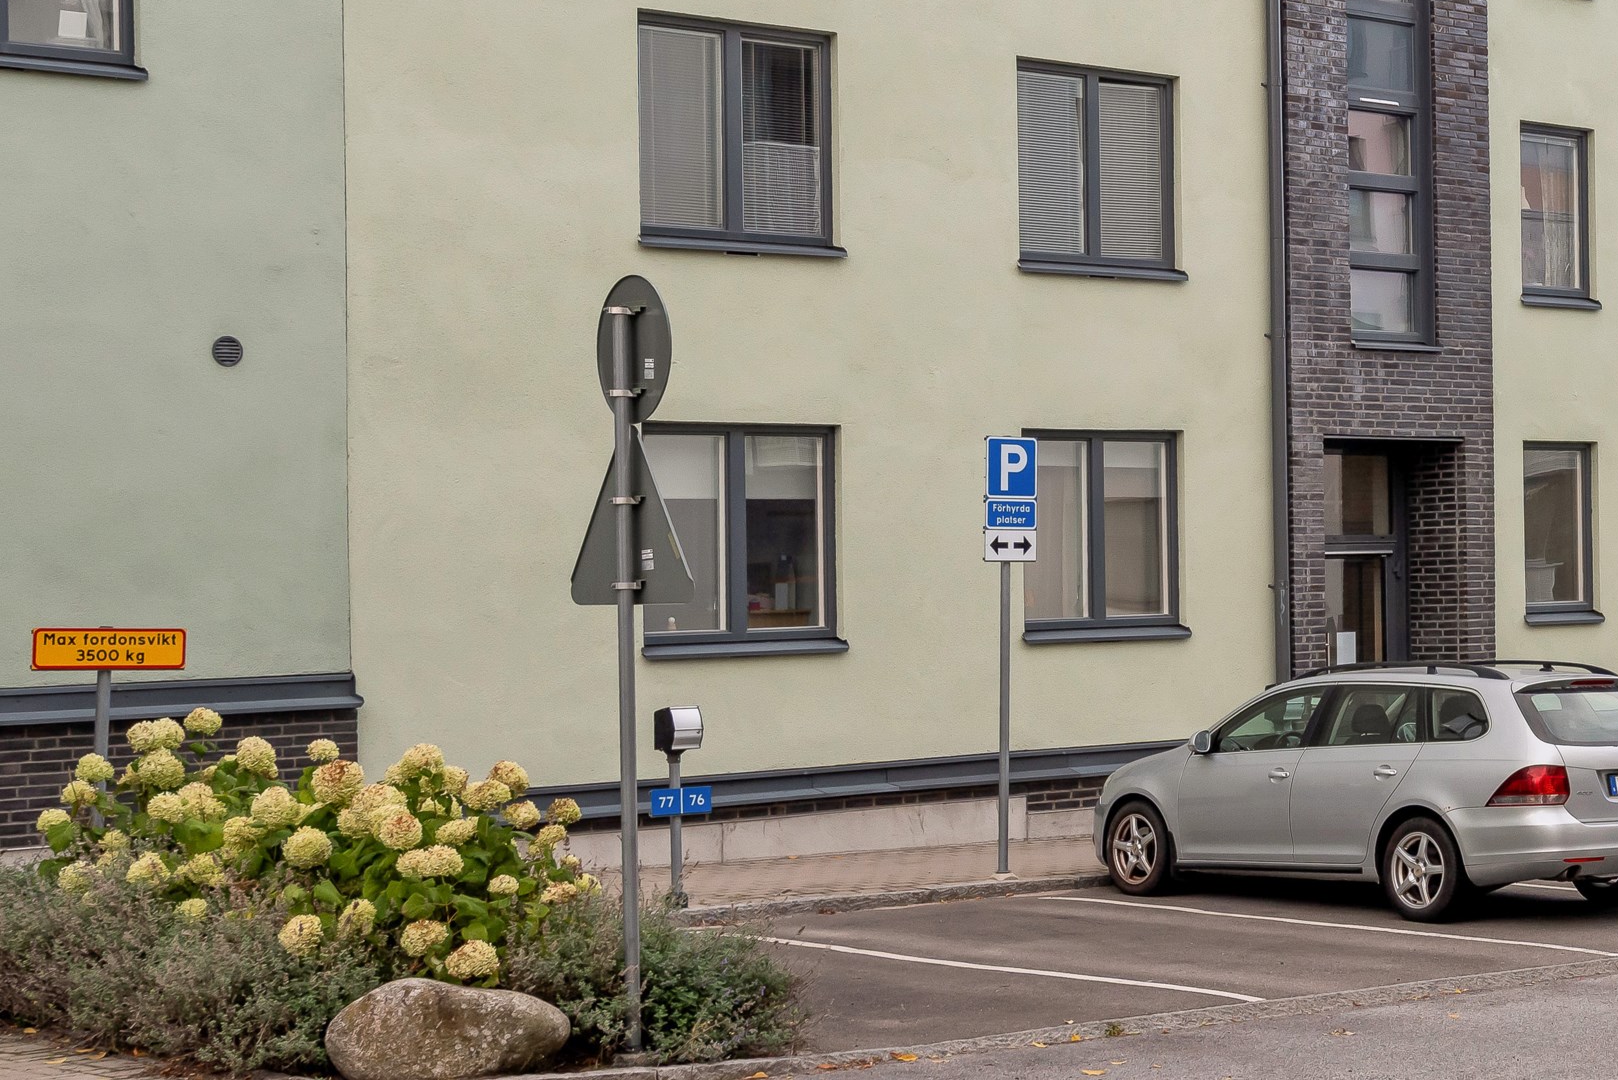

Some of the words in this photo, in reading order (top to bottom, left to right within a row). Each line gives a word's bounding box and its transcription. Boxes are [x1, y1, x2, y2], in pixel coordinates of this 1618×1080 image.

[1000, 443, 1028, 491] P
[992, 503, 1031, 515] Förhyrda
[996, 516, 1026, 526] platser
[43, 633, 76, 646] Max
[83, 633, 177, 646] fordonsvikt
[76, 649, 119, 662] 3500
[125, 649, 145, 664] kg
[658, 796, 674, 808] 77
[689, 794, 705, 806] 76
